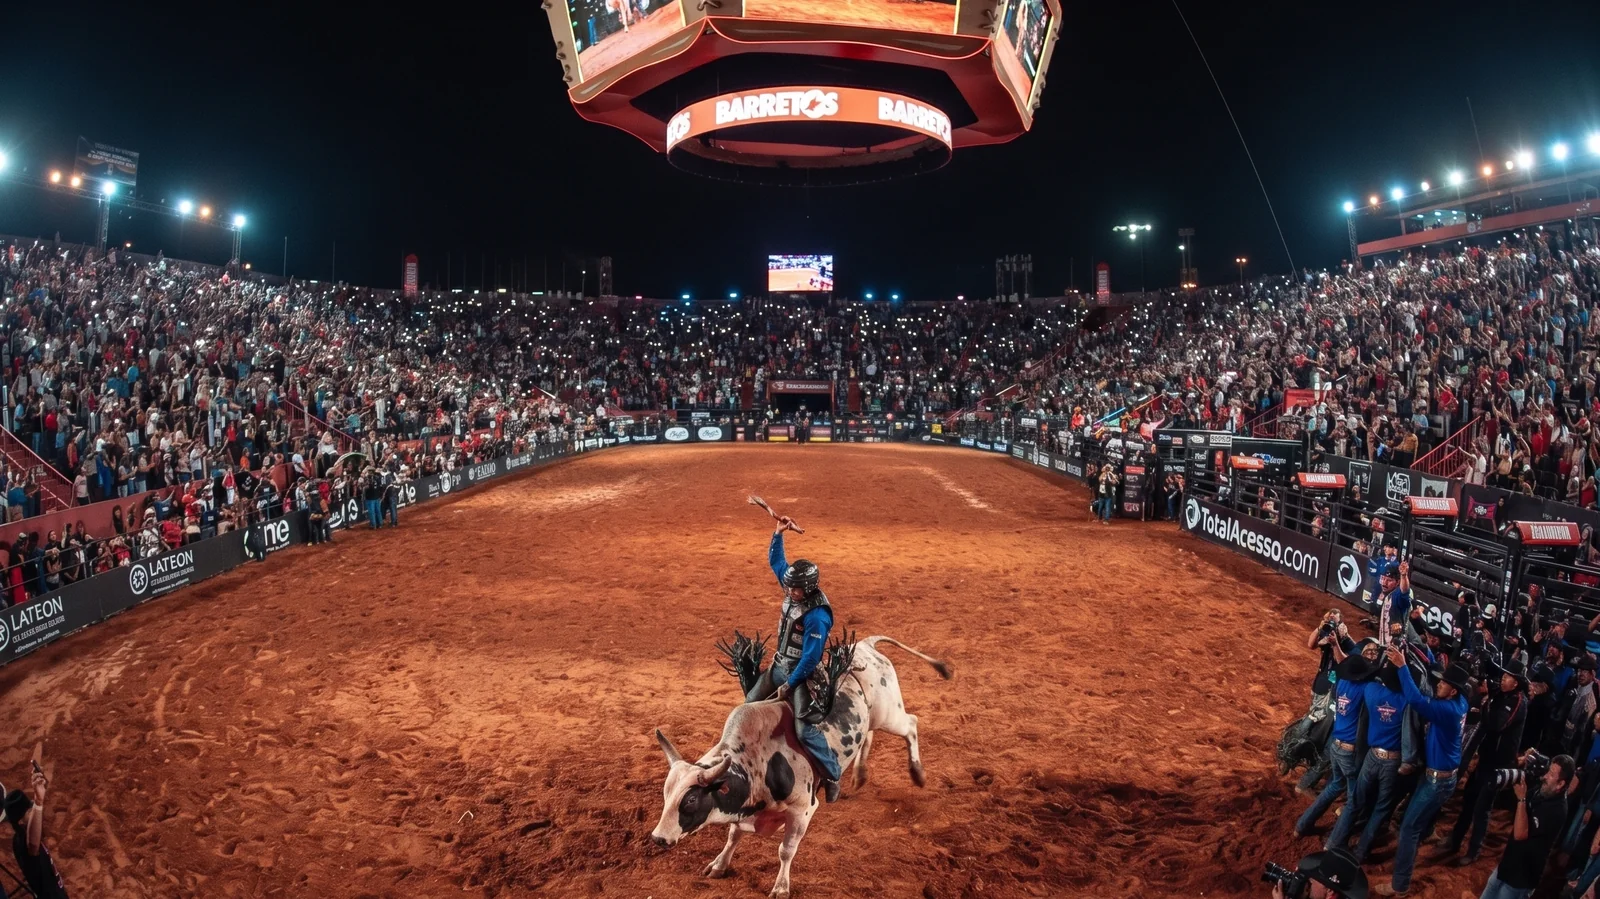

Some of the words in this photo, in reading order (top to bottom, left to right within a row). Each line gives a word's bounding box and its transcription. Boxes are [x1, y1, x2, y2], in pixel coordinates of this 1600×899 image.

[715, 89, 838, 124] BARRETOS
[1201, 506, 1319, 579] TotalAcesso.com
[149, 549, 194, 577] LATEON
[10, 595, 64, 631] LATEON
